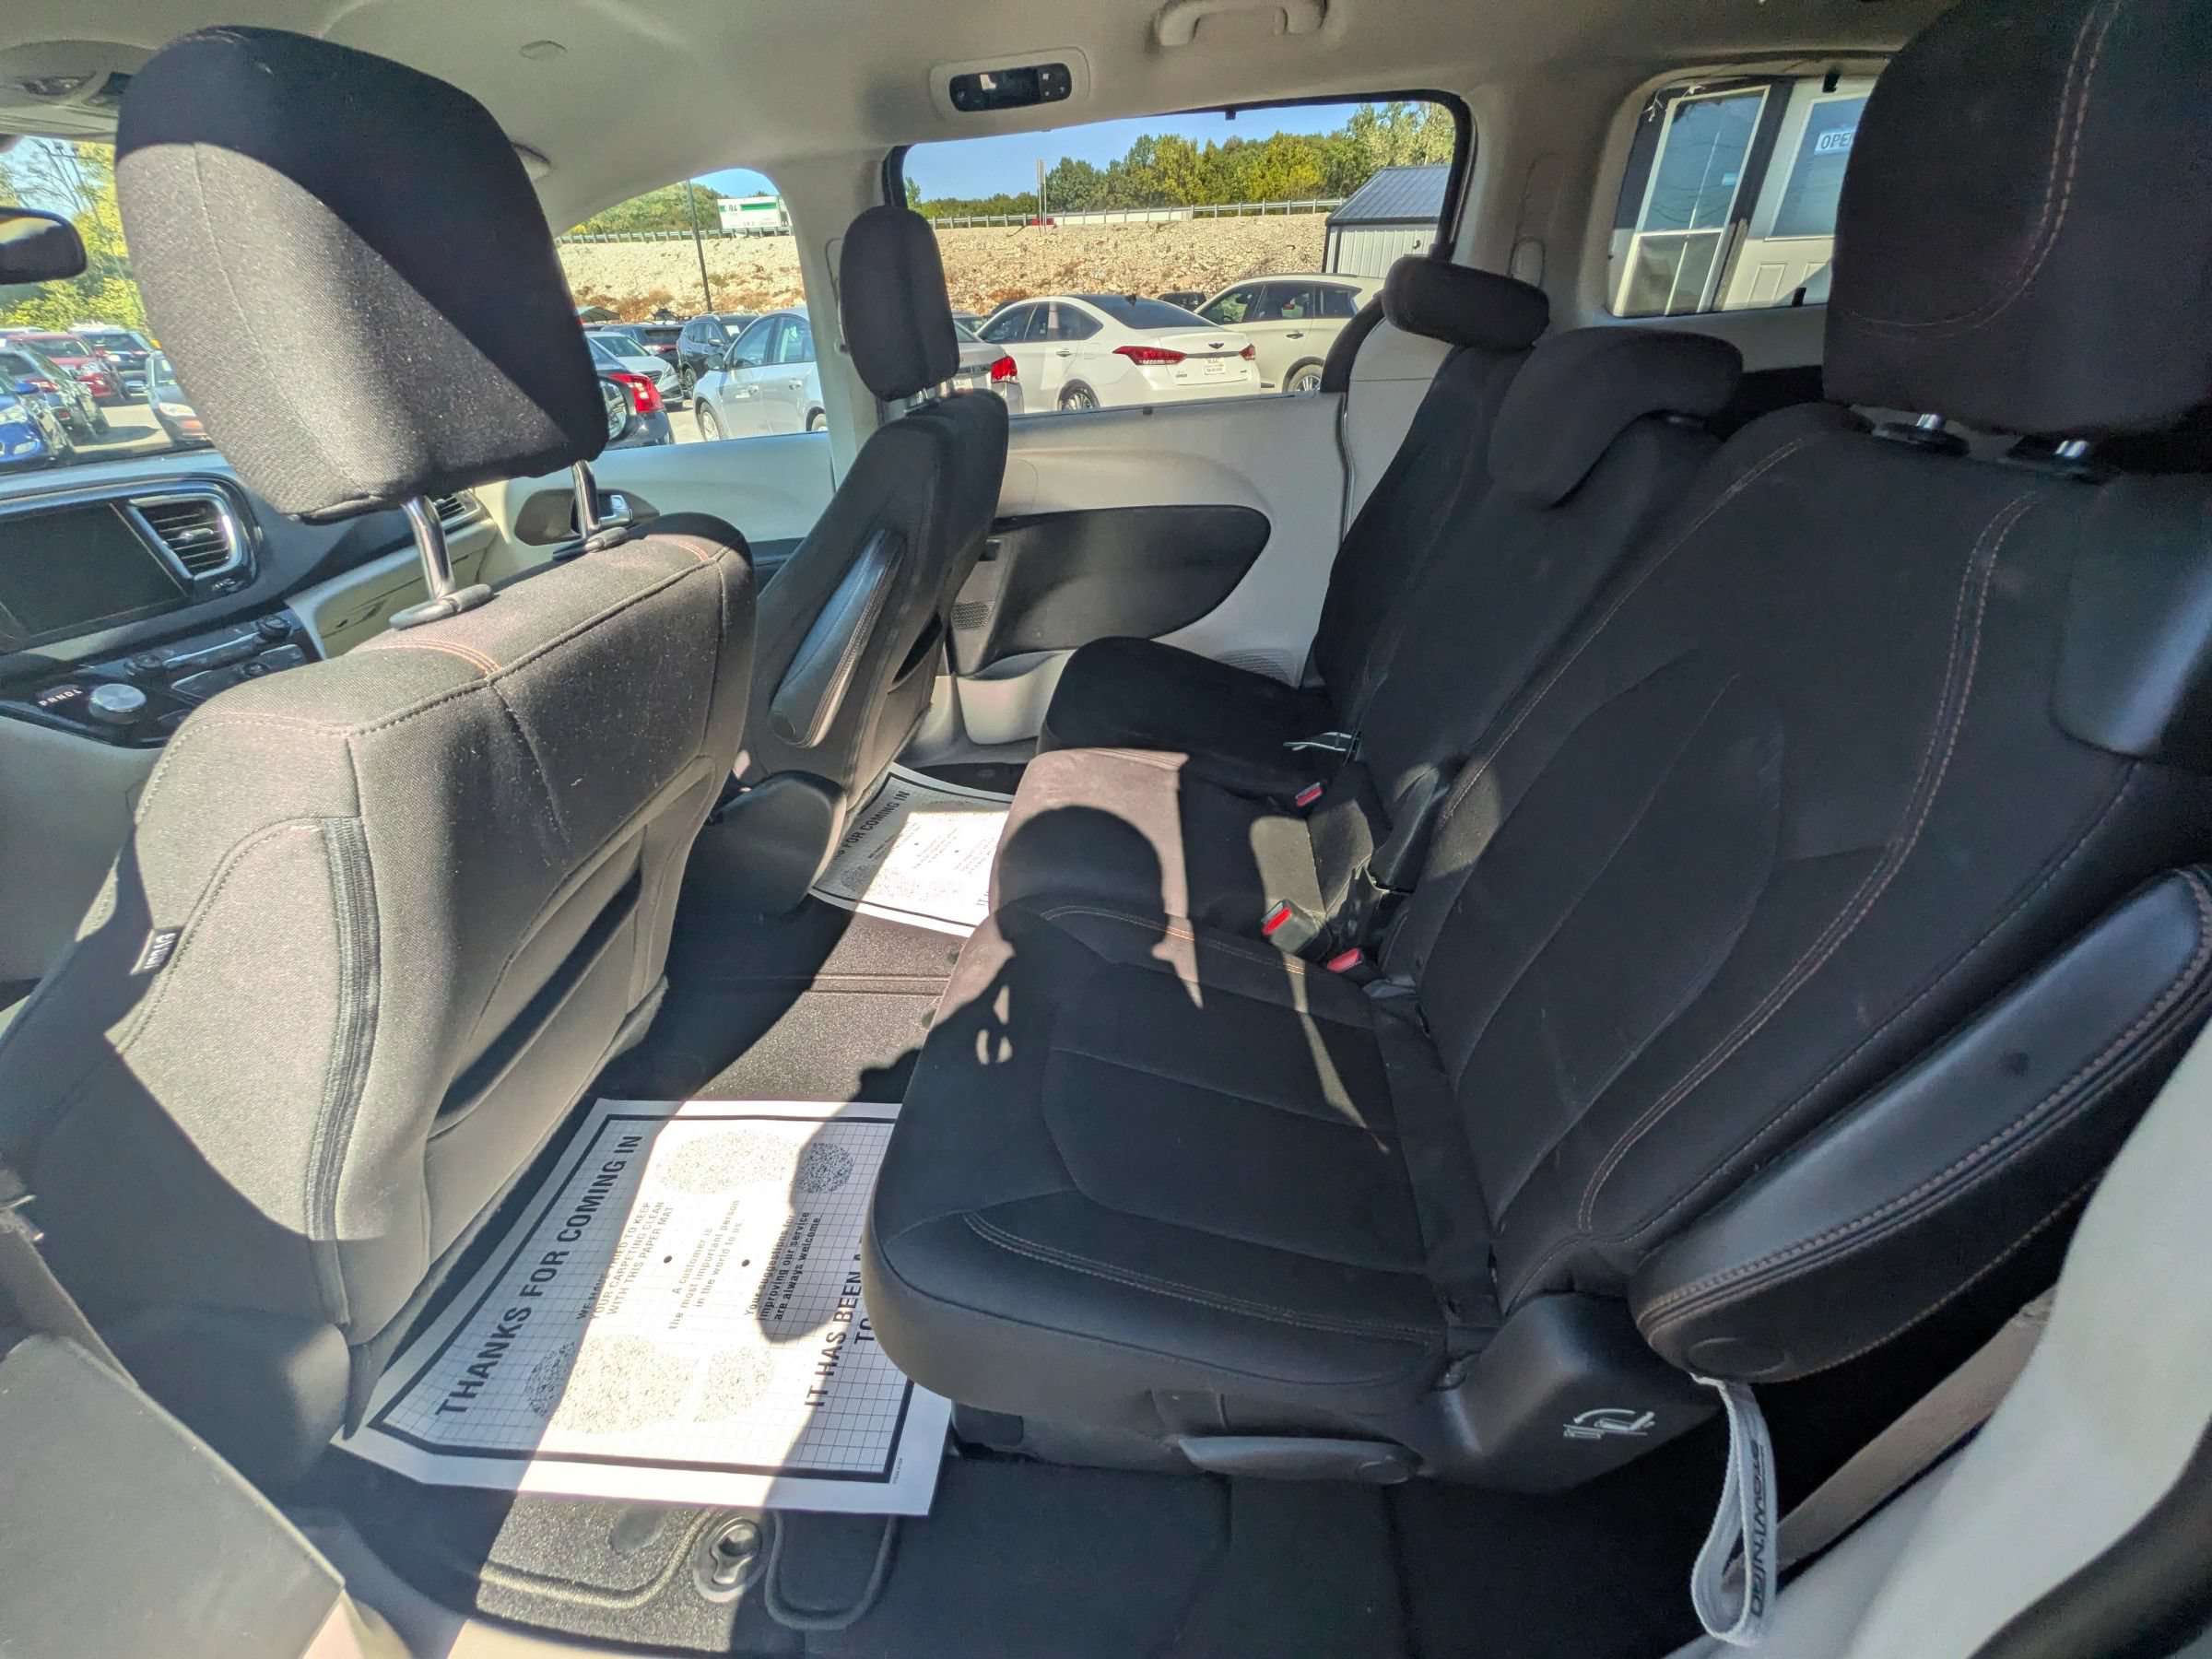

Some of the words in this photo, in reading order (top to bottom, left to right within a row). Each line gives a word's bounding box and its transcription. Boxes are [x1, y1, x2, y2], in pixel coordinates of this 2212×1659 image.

[1821, 132, 1851, 148] OPE
[845, 831, 866, 849] FOR
[860, 802, 900, 832] COMING
[894, 790, 911, 801] IN
[435, 1307, 532, 1416] THANKS
[519, 1250, 570, 1298] FOR
[557, 1159, 628, 1242] COMING
[614, 1135, 642, 1154] IN
[576, 1303, 591, 1319] WE
[608, 1241, 629, 1269] TRIED
[625, 1227, 637, 1238] TO
[633, 1202, 650, 1224] KEEP
[590, 1290, 613, 1319] YOUR
[609, 1232, 646, 1288] CARPETING
[642, 1202, 664, 1230] CLEAN
[606, 1288, 629, 1315] WITH
[624, 1261, 643, 1283] THIS
[639, 1229, 663, 1258] PAPER
[657, 1206, 674, 1225] MAT
[668, 1312, 684, 1329] the
[680, 1284, 699, 1308] most
[693, 1234, 724, 1280] important
[720, 1200, 740, 1230] person
[678, 1240, 706, 1284] customer
[702, 1228, 713, 1236] is
[693, 1298, 706, 1307] in
[700, 1278, 715, 1294] the
[712, 1248, 730, 1276] world
[724, 1236, 735, 1245] to
[744, 1293, 761, 1316] Your
[759, 1230, 788, 1290] suggestions
[782, 1214, 794, 1228] for
[757, 1269, 789, 1320] improving
[782, 1249, 795, 1266] our
[790, 1212, 809, 1247] service
[774, 1303, 788, 1320] are
[783, 1264, 804, 1300] always
[798, 1215, 824, 1261] welcome.
[832, 1271, 862, 1323] BEEN
[804, 1384, 829, 1407] IT
[815, 1330, 846, 1376] HAS
